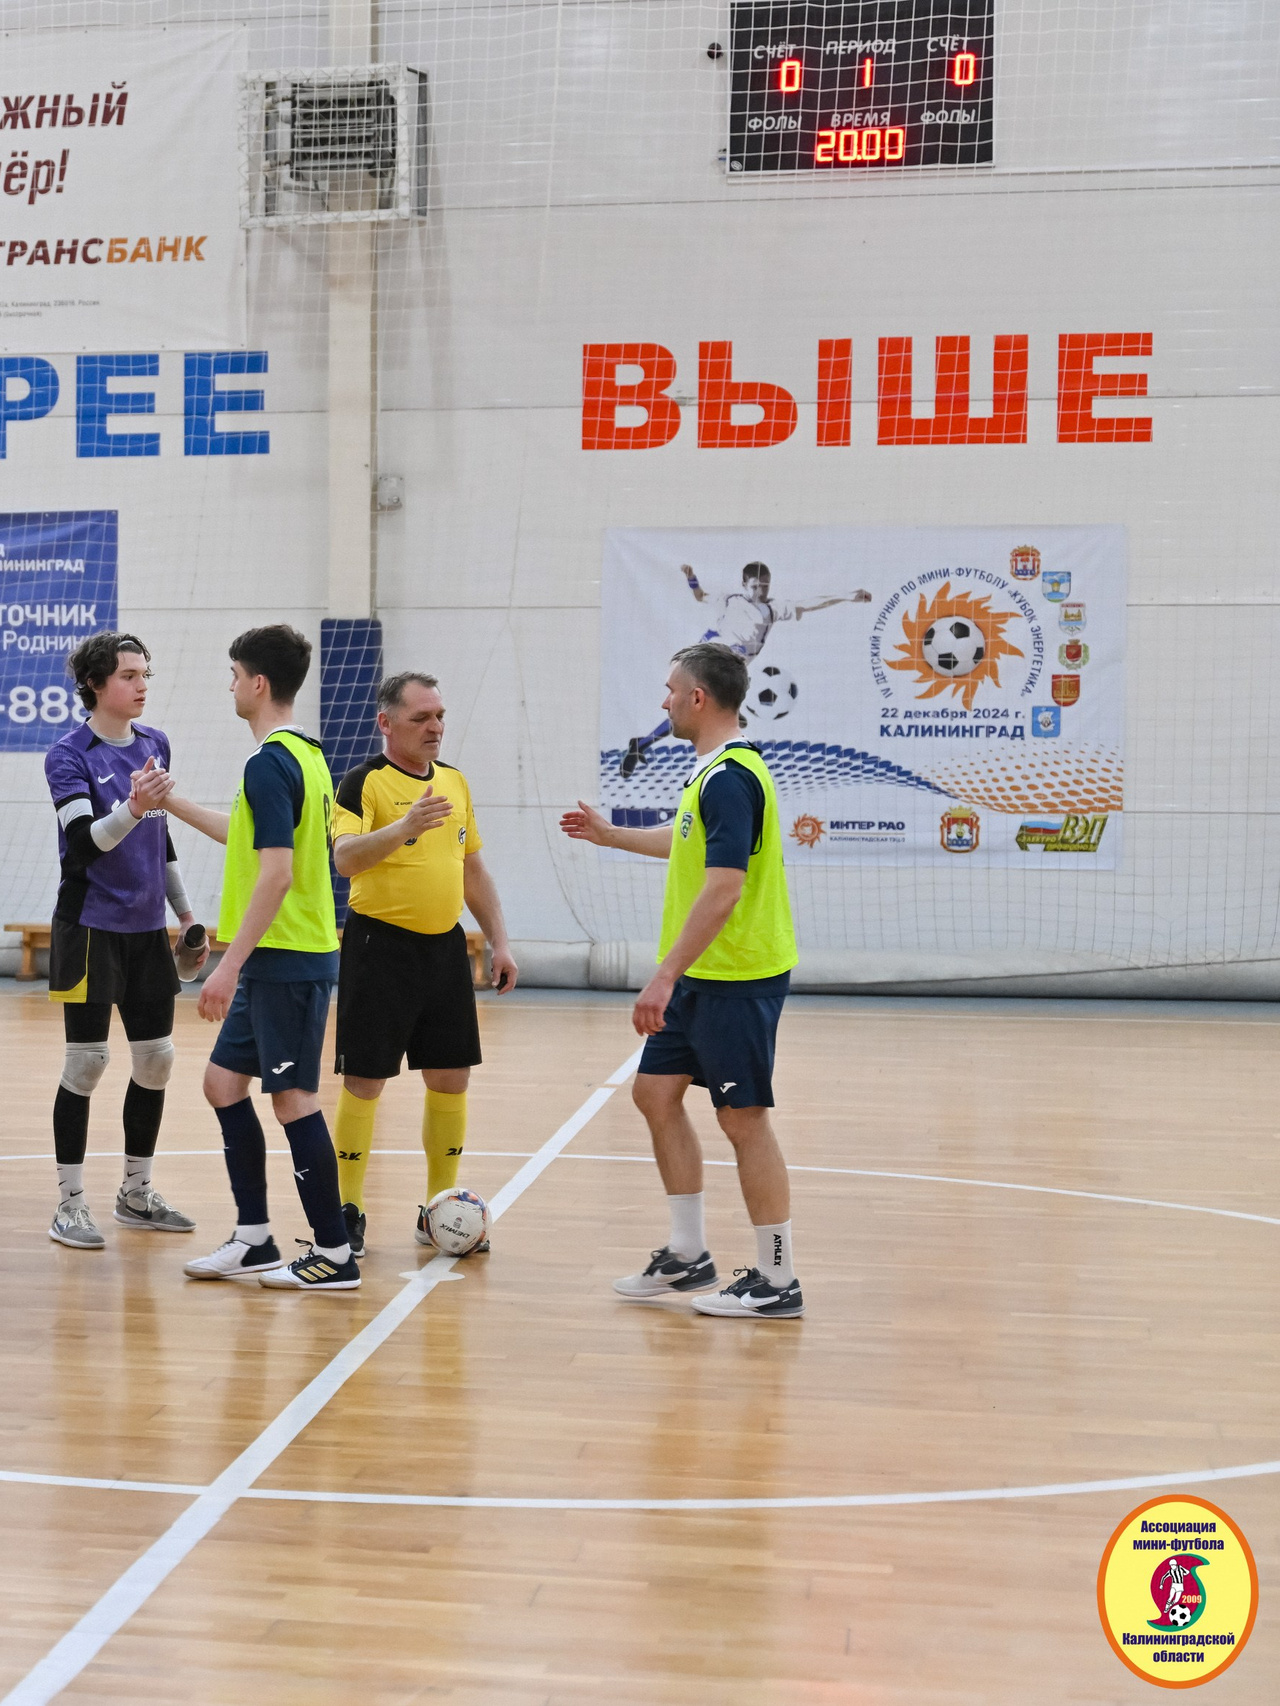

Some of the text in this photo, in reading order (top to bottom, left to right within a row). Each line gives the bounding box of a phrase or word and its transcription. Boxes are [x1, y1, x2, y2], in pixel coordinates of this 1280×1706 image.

[826, 38, 896, 56] ПЕРИОД
[781, 60, 801, 92] 0
[864, 58, 872, 88] 1
[954, 54, 975, 85] 0
[748, 115, 802, 130] ФОЛЫ
[830, 112, 891, 128] ВРЕМЯ
[921, 109, 976, 124] ФОЛЫ
[581, 332, 1154, 450] ВЫШЕ
[918, 567, 1009, 590] МИНИ-ФУТБОЛУ
[901, 580, 917, 596] ПО
[873, 592, 901, 635] ТУРНИР
[870, 636, 889, 686] ДЕТСКИЙ
[881, 707, 1026, 721] 22 декабря 2024 г.
[880, 724, 1025, 740] КАЛИНИНГРАД
[830, 820, 905, 831] ИНТЕР РАО
[440, 1223, 470, 1239] DEMIX
[773, 1233, 782, 1266] ATHLEX
